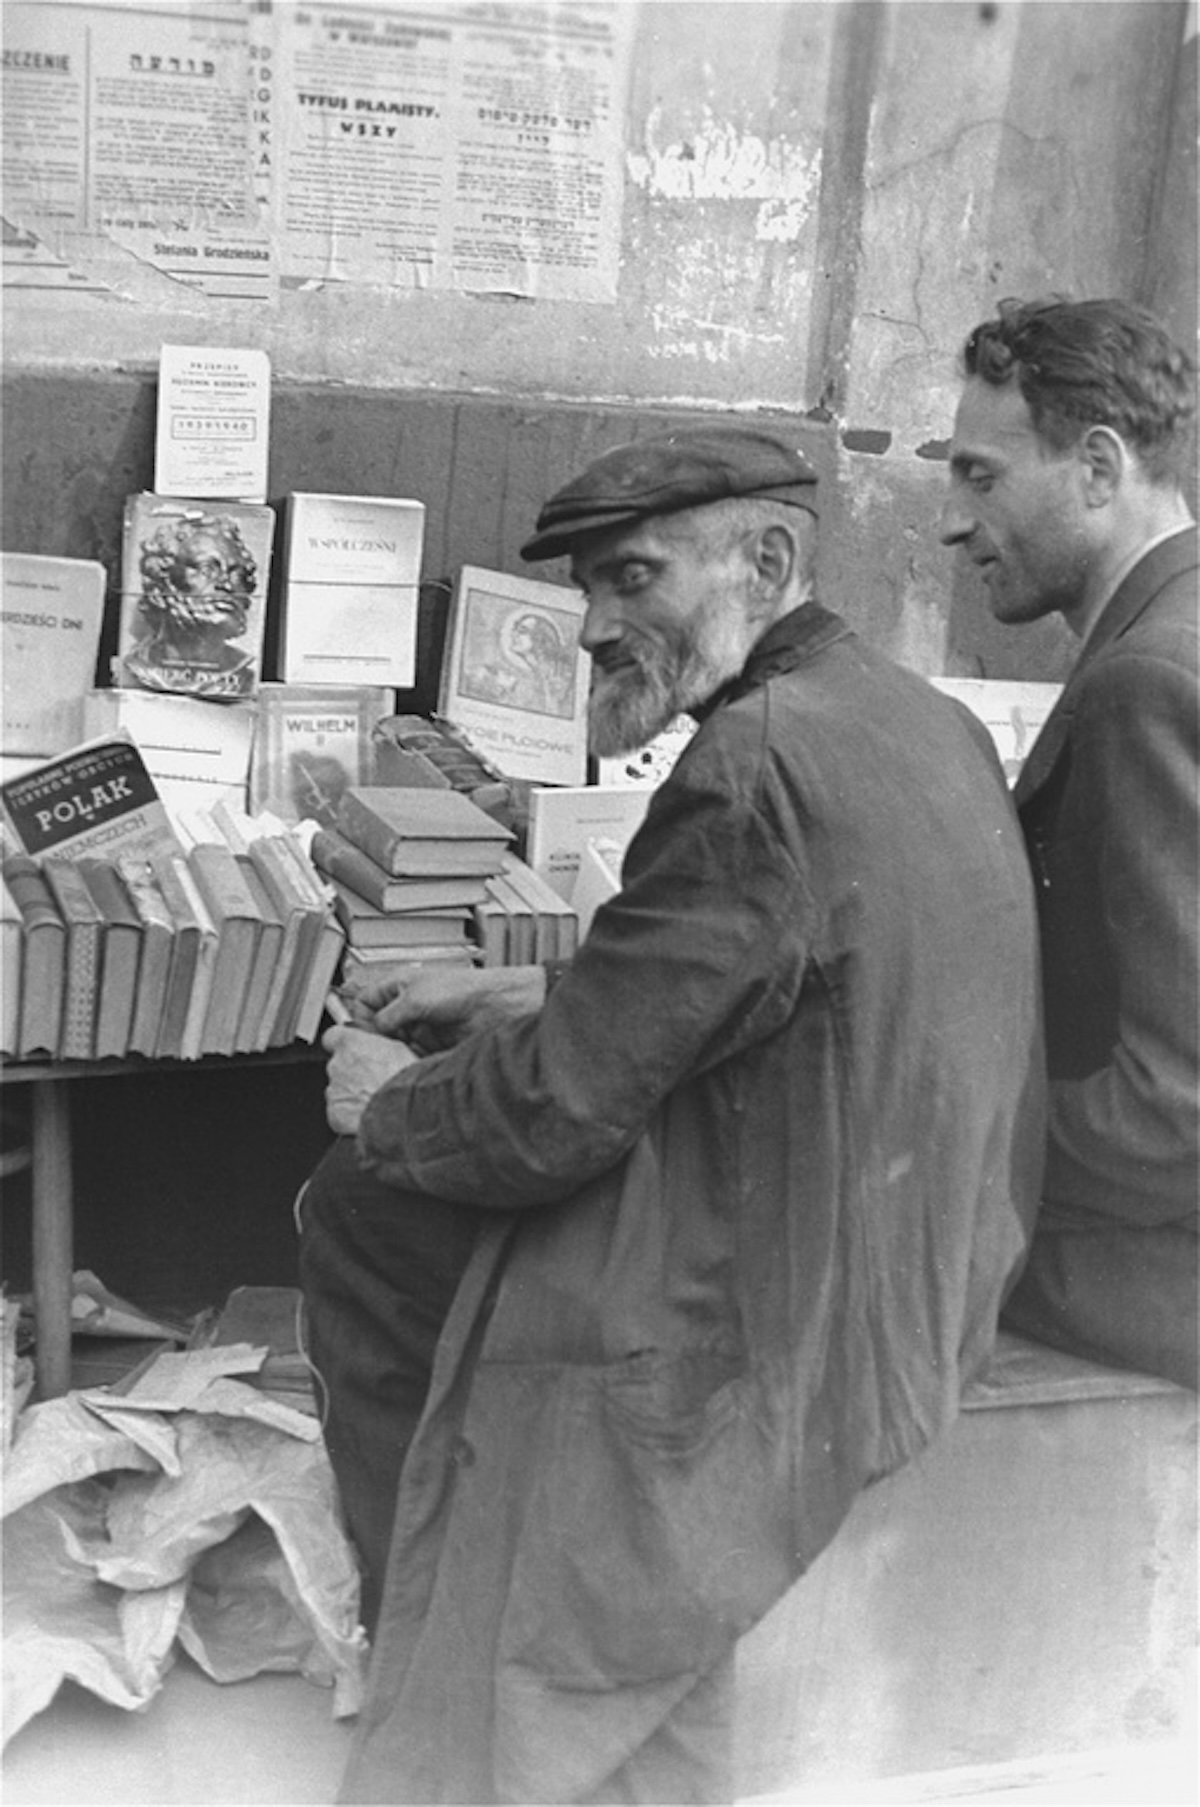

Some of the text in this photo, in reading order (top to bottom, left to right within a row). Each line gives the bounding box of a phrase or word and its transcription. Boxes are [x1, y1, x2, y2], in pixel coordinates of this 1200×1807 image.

[297, 93, 441, 119] TYFUS PLAMISTY.
[340, 121, 397, 138] WSZY
[153, 243, 198, 258] Stefania
[286, 718, 357, 733] WILHELM
[35, 775, 133, 832] POLAK
